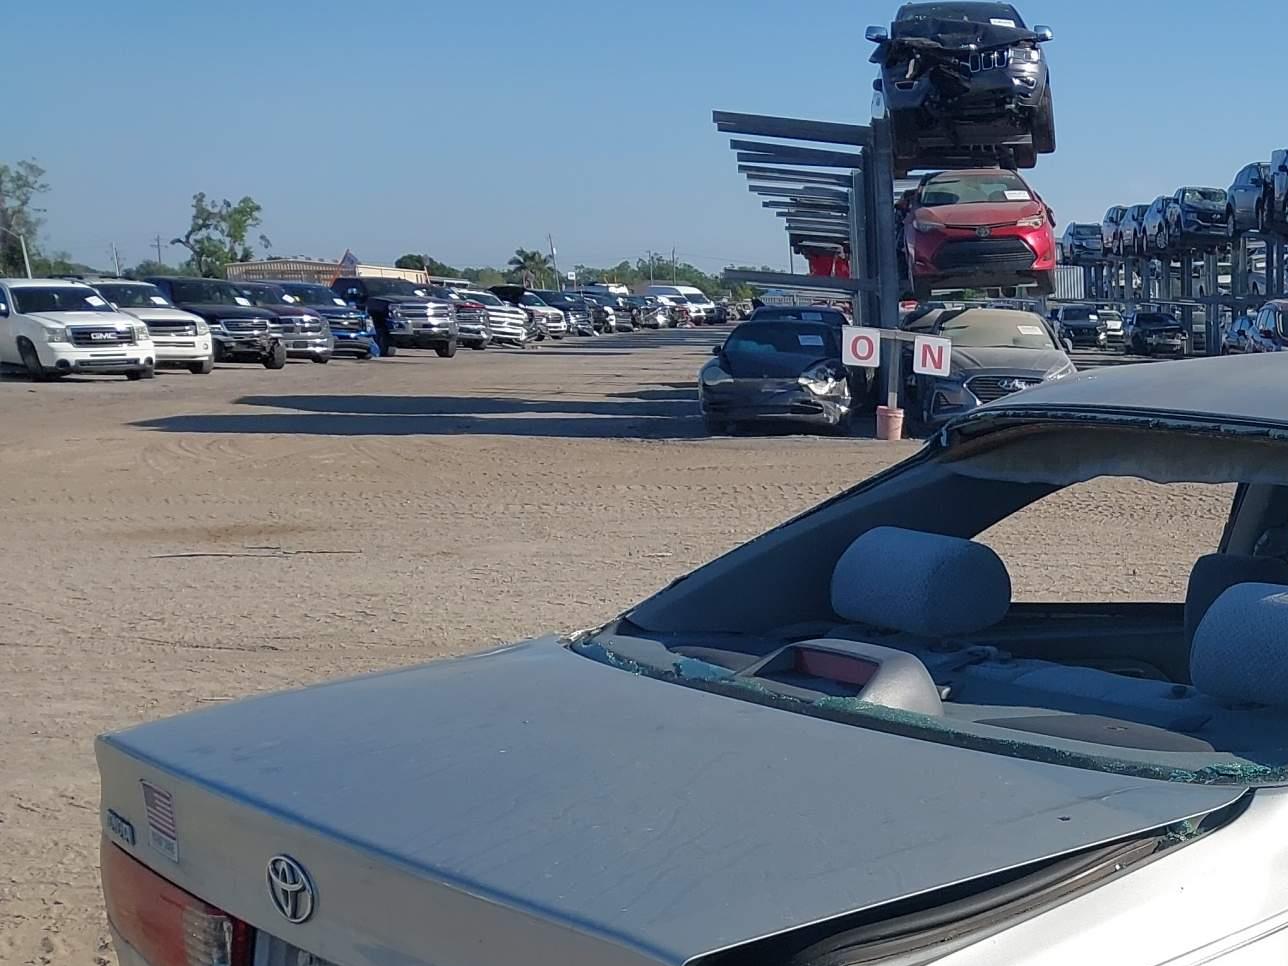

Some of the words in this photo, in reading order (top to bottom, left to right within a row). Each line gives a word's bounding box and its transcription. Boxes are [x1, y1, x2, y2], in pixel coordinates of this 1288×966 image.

[90, 332, 118, 340] GMC
[851, 335, 875, 361] O
[921, 343, 944, 370] N
